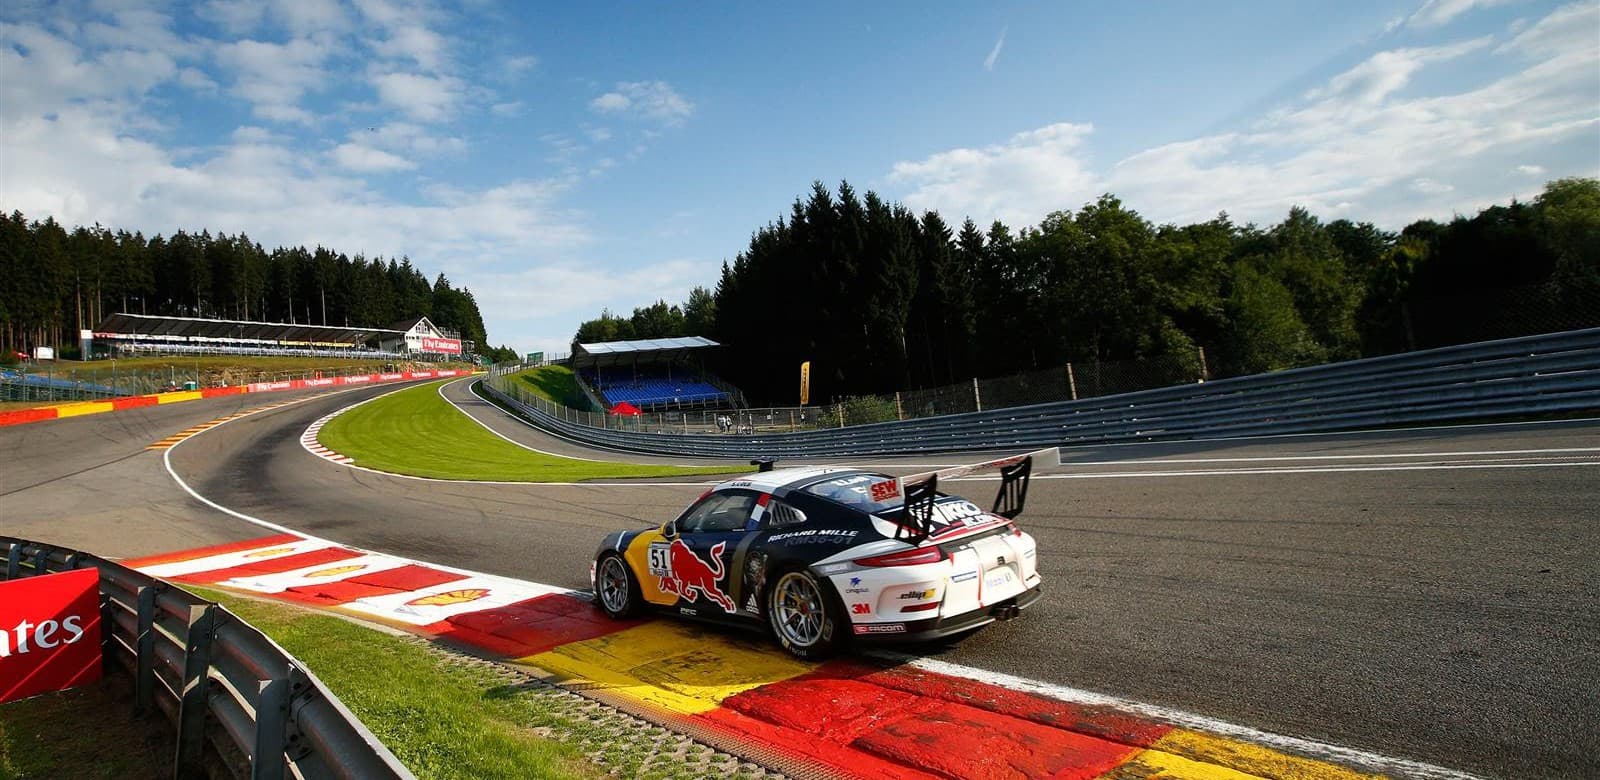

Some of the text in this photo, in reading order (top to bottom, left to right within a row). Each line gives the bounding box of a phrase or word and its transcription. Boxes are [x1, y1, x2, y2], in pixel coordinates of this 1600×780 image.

[423, 338, 459, 350] Fly Emirates
[870, 479, 897, 497] SEW
[767, 529, 859, 542] RICHARD MILLE
[651, 549, 667, 569] 51
[851, 603, 871, 614] 3M
